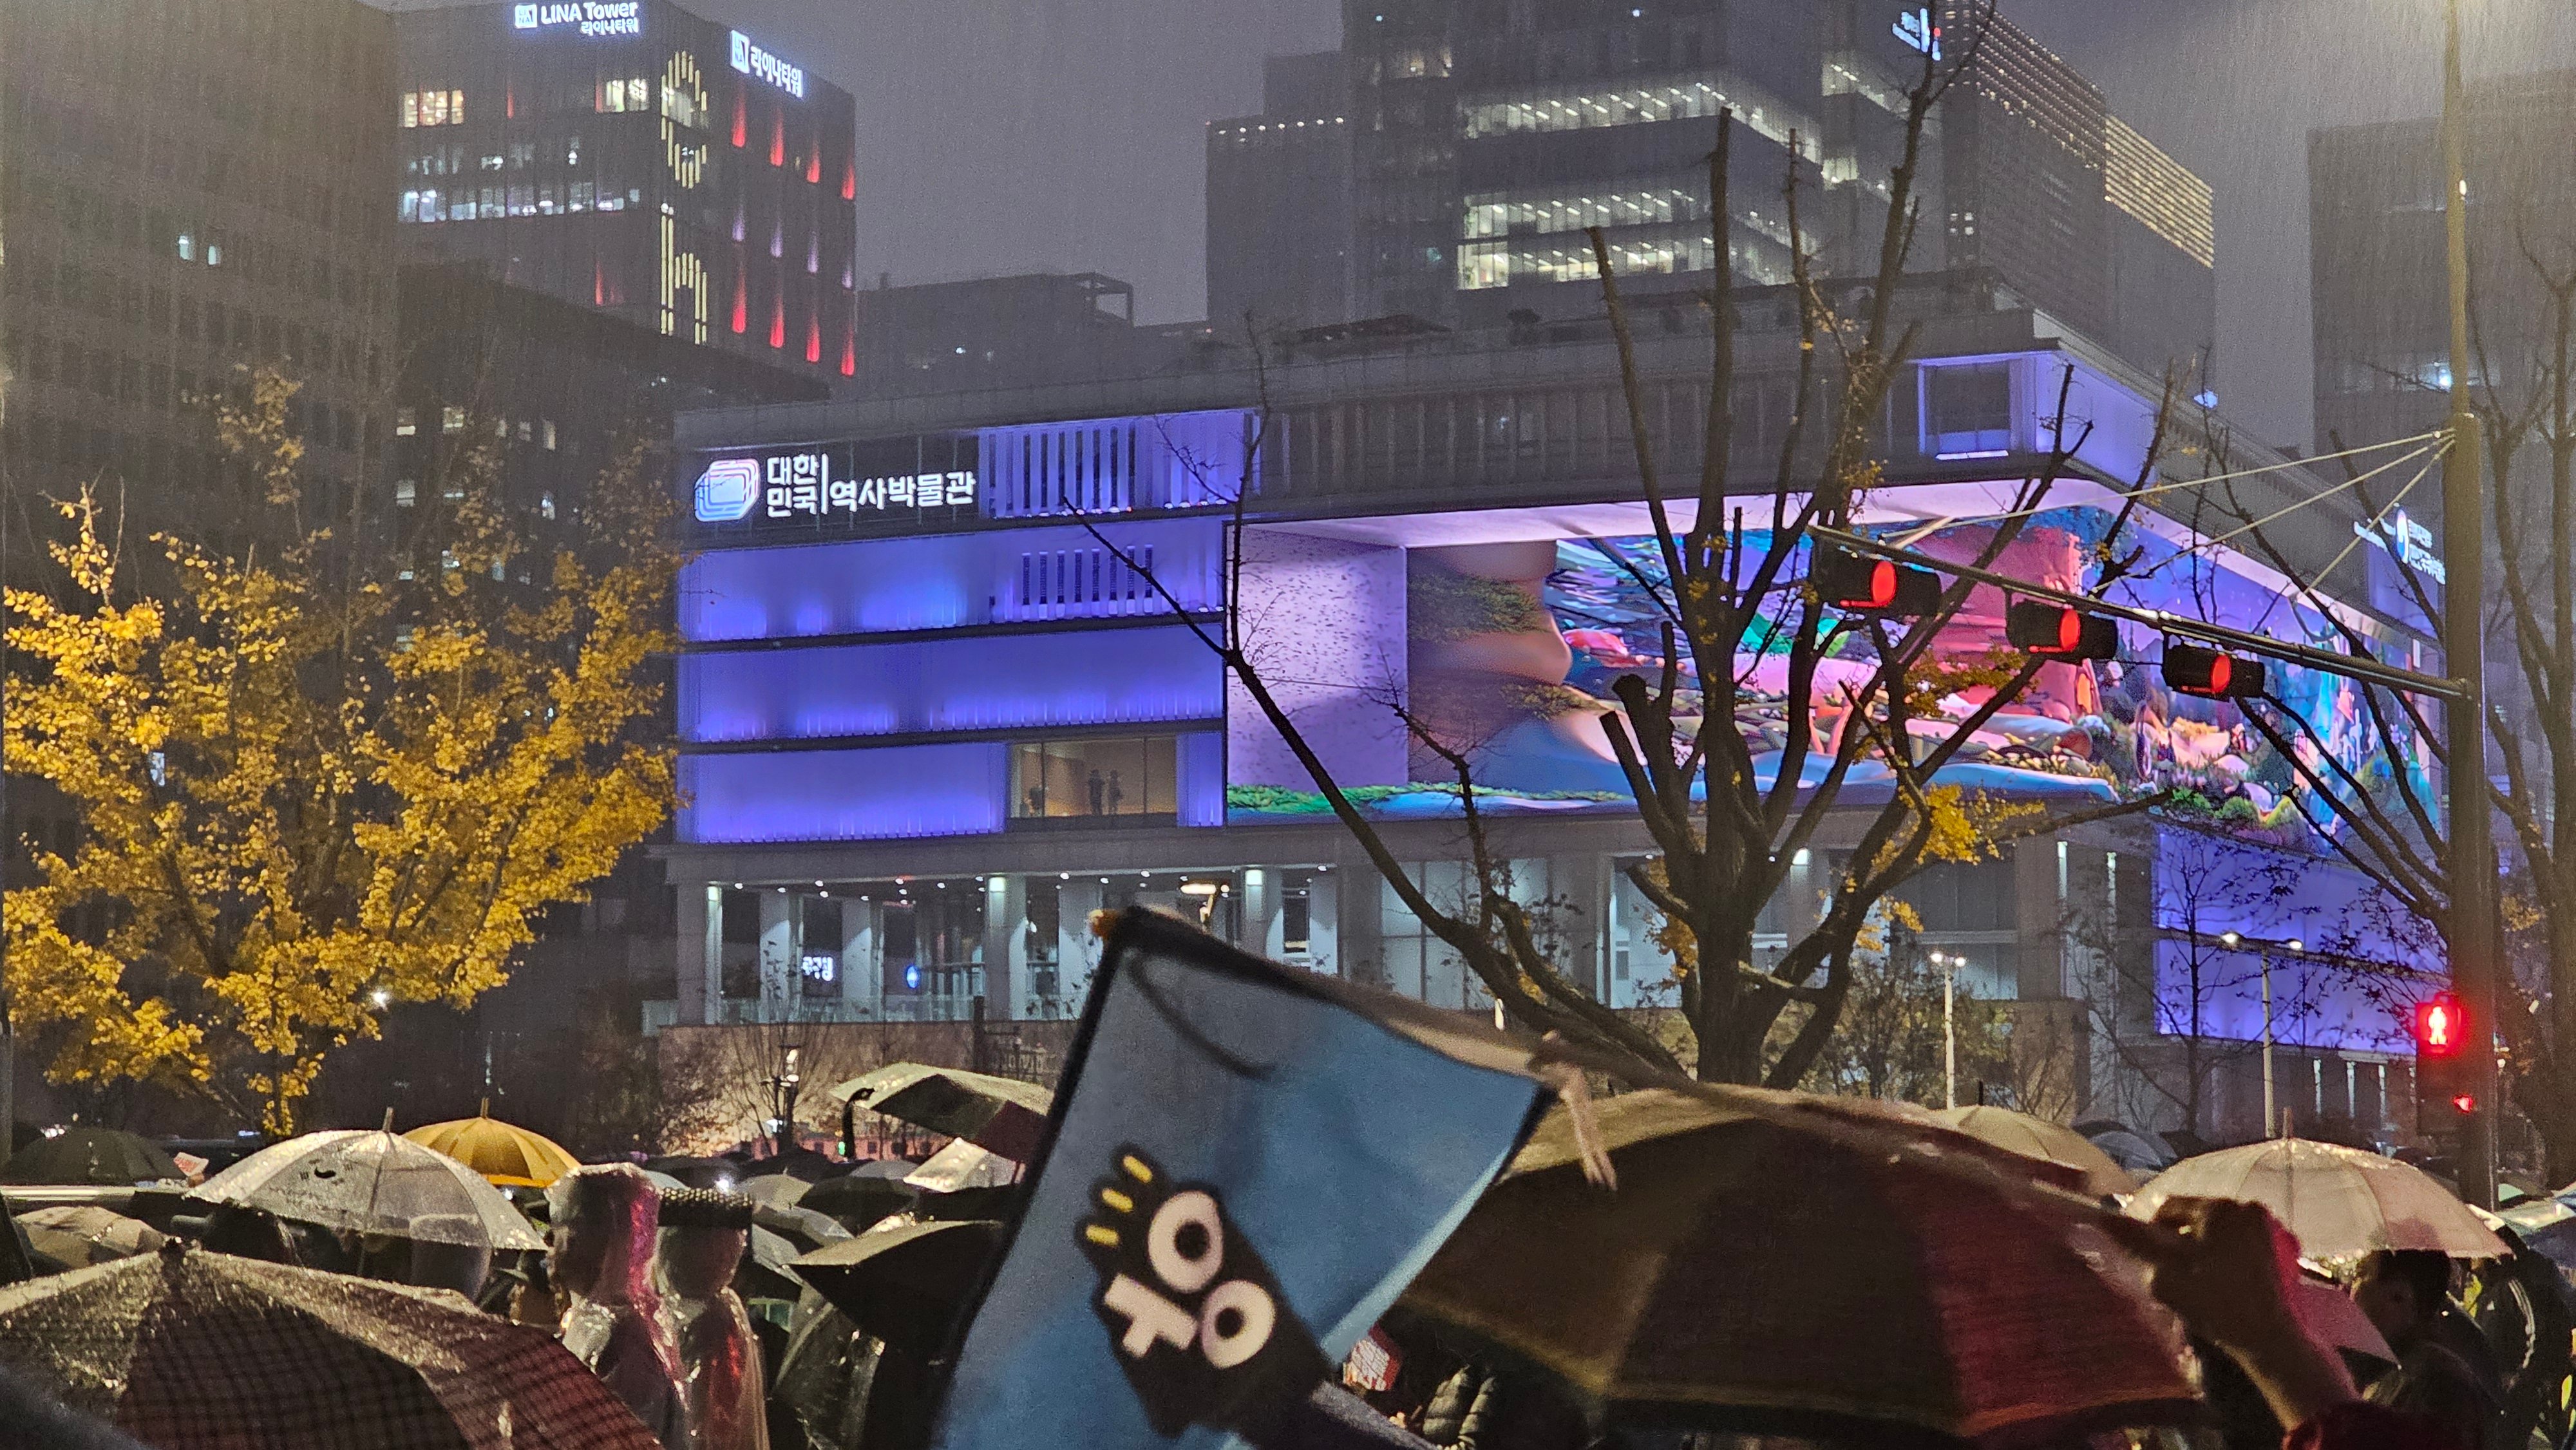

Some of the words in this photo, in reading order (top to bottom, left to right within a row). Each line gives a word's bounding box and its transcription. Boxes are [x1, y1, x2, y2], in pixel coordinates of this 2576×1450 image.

[541, 3, 582, 24] LINA
[583, 2, 638, 20] Tower
[581, 18, 639, 36] 라이나타워
[750, 46, 804, 98] 라이나타워
[766, 453, 819, 486] 대한
[766, 486, 818, 518] 민국
[829, 470, 977, 513] 역사박물관
